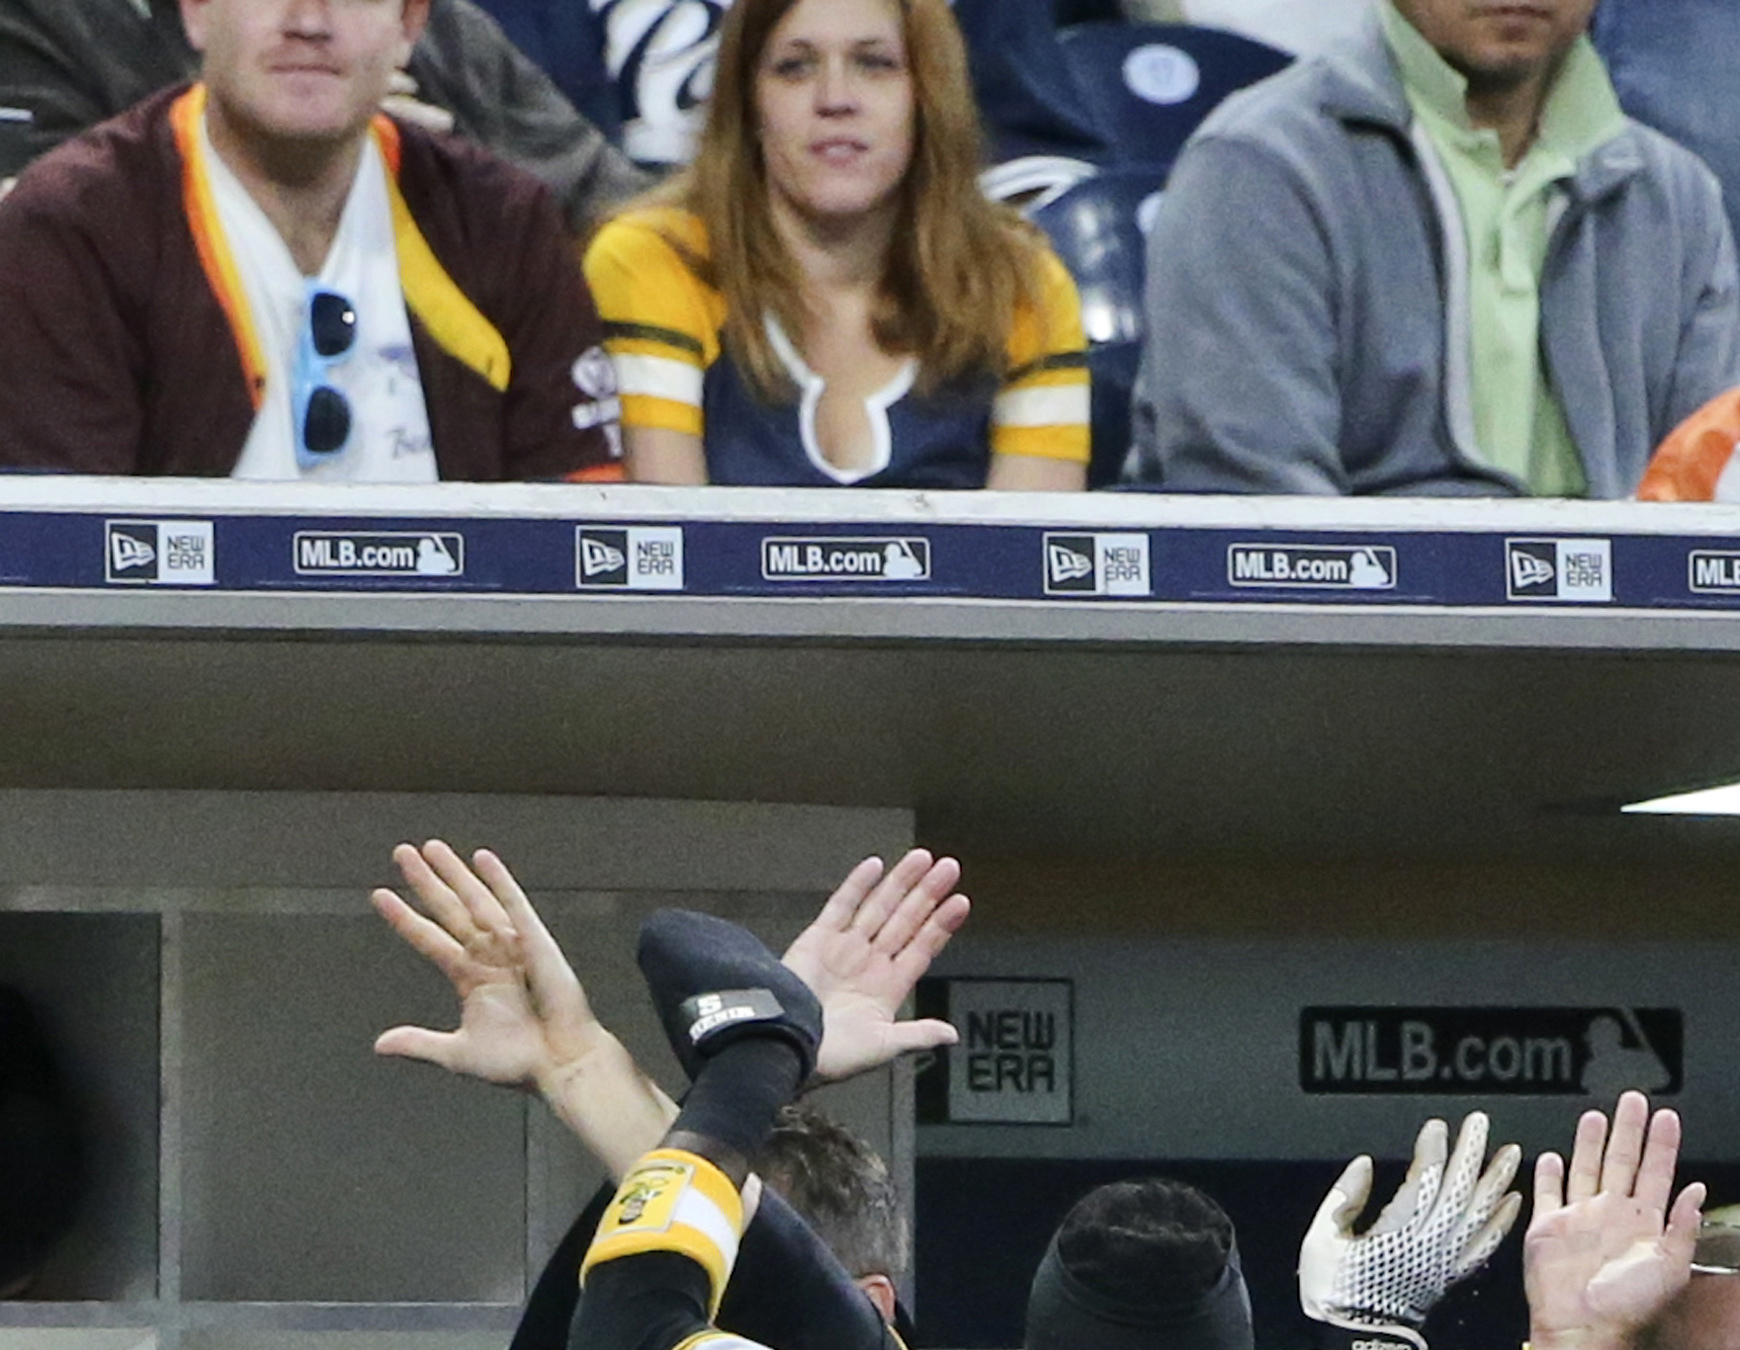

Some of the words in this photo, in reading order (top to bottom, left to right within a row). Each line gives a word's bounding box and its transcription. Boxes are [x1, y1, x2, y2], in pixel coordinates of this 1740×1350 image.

[167, 535, 205, 551] NEW
[637, 541, 674, 557] NEW
[167, 552, 205, 569] ERA
[301, 540, 414, 567] MLB.com
[769, 546, 881, 573] MLB.com
[1104, 547, 1141, 563] NEW
[1566, 552, 1602, 569] NEW
[637, 558, 674, 575] ERA
[1104, 564, 1141, 581] ERA
[1235, 553, 1347, 580] MLB.com
[1566, 570, 1602, 587] ERA
[967, 1010, 1055, 1049] NEW
[1313, 1020, 1573, 1081] MLB.com
[967, 1053, 1055, 1093] ERA
